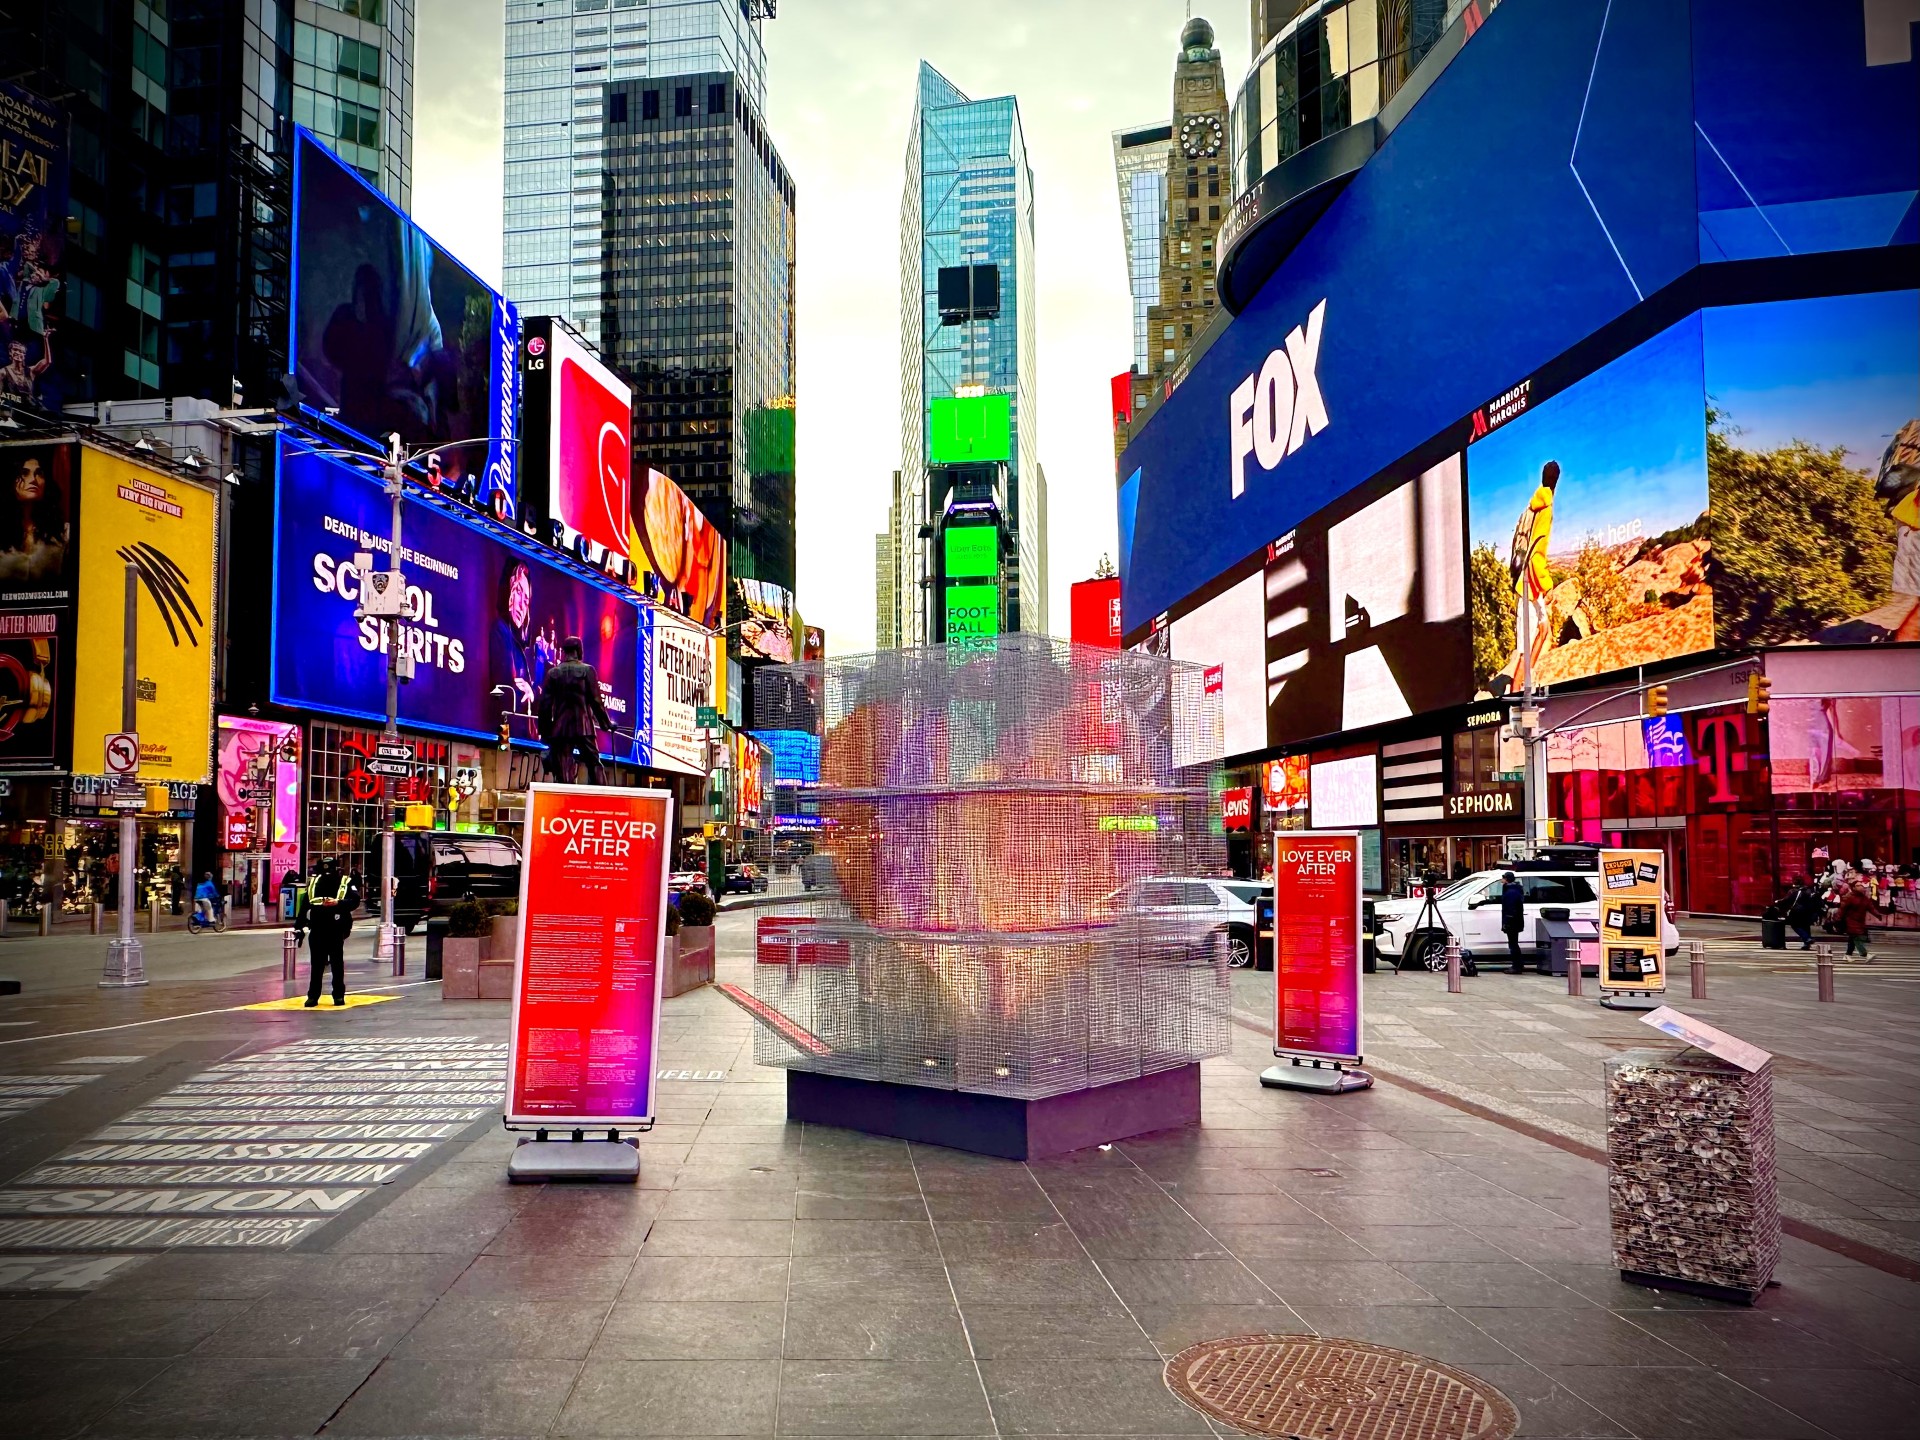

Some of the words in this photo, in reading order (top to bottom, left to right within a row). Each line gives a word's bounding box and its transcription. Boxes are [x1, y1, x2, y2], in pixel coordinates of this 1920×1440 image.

[528, 358, 545, 371] LG
[1230, 297, 1329, 499] FOX
[1489, 380, 1531, 413] MARRIOTT
[1489, 397, 1527, 427] MARQUIS
[119, 486, 140, 502] VERY
[324, 515, 358, 541] DEATH
[370, 538, 393, 553] JUST
[413, 551, 459, 580] BEGINNING
[313, 553, 439, 628] SCOL
[948, 606, 996, 620] FOOT-
[0, 616, 25, 634] AFTER
[27, 614, 56, 633] ROMEO
[948, 621, 985, 634] BALL
[659, 640, 685, 678] AFTER
[667, 672, 679, 703] TIL
[1467, 711, 1501, 728] SEPHORA
[382, 747, 393, 755] ONE
[73, 776, 119, 795] GIFTS
[1449, 793, 1513, 815] SEPHORA
[540, 817, 595, 837] LOVE
[601, 820, 656, 840] EVER
[564, 837, 630, 857] AFTER
[1282, 850, 1314, 863] LOVE
[1317, 850, 1352, 863] EVER
[1296, 863, 1336, 876] AFTER
[232, 1052, 386, 1062] LYRIC
[322, 1060, 508, 1071] JAME
[374, 1081, 507, 1092] IMPERIA
[194, 1094, 394, 1106] FONTANNE
[343, 1111, 484, 1121] FRIEDMAN
[128, 1125, 284, 1140] KERR
[312, 1124, 454, 1138] O'NEILL
[57, 1143, 432, 1161] AMBASSADOR
[34, 1166, 184, 1176] CIRCLE
[160, 1164, 405, 1183] GERSHWIN
[25, 1189, 366, 1213] SIMON
[191, 1218, 321, 1230] AUGUST
[162, 1230, 304, 1246] WILSON
